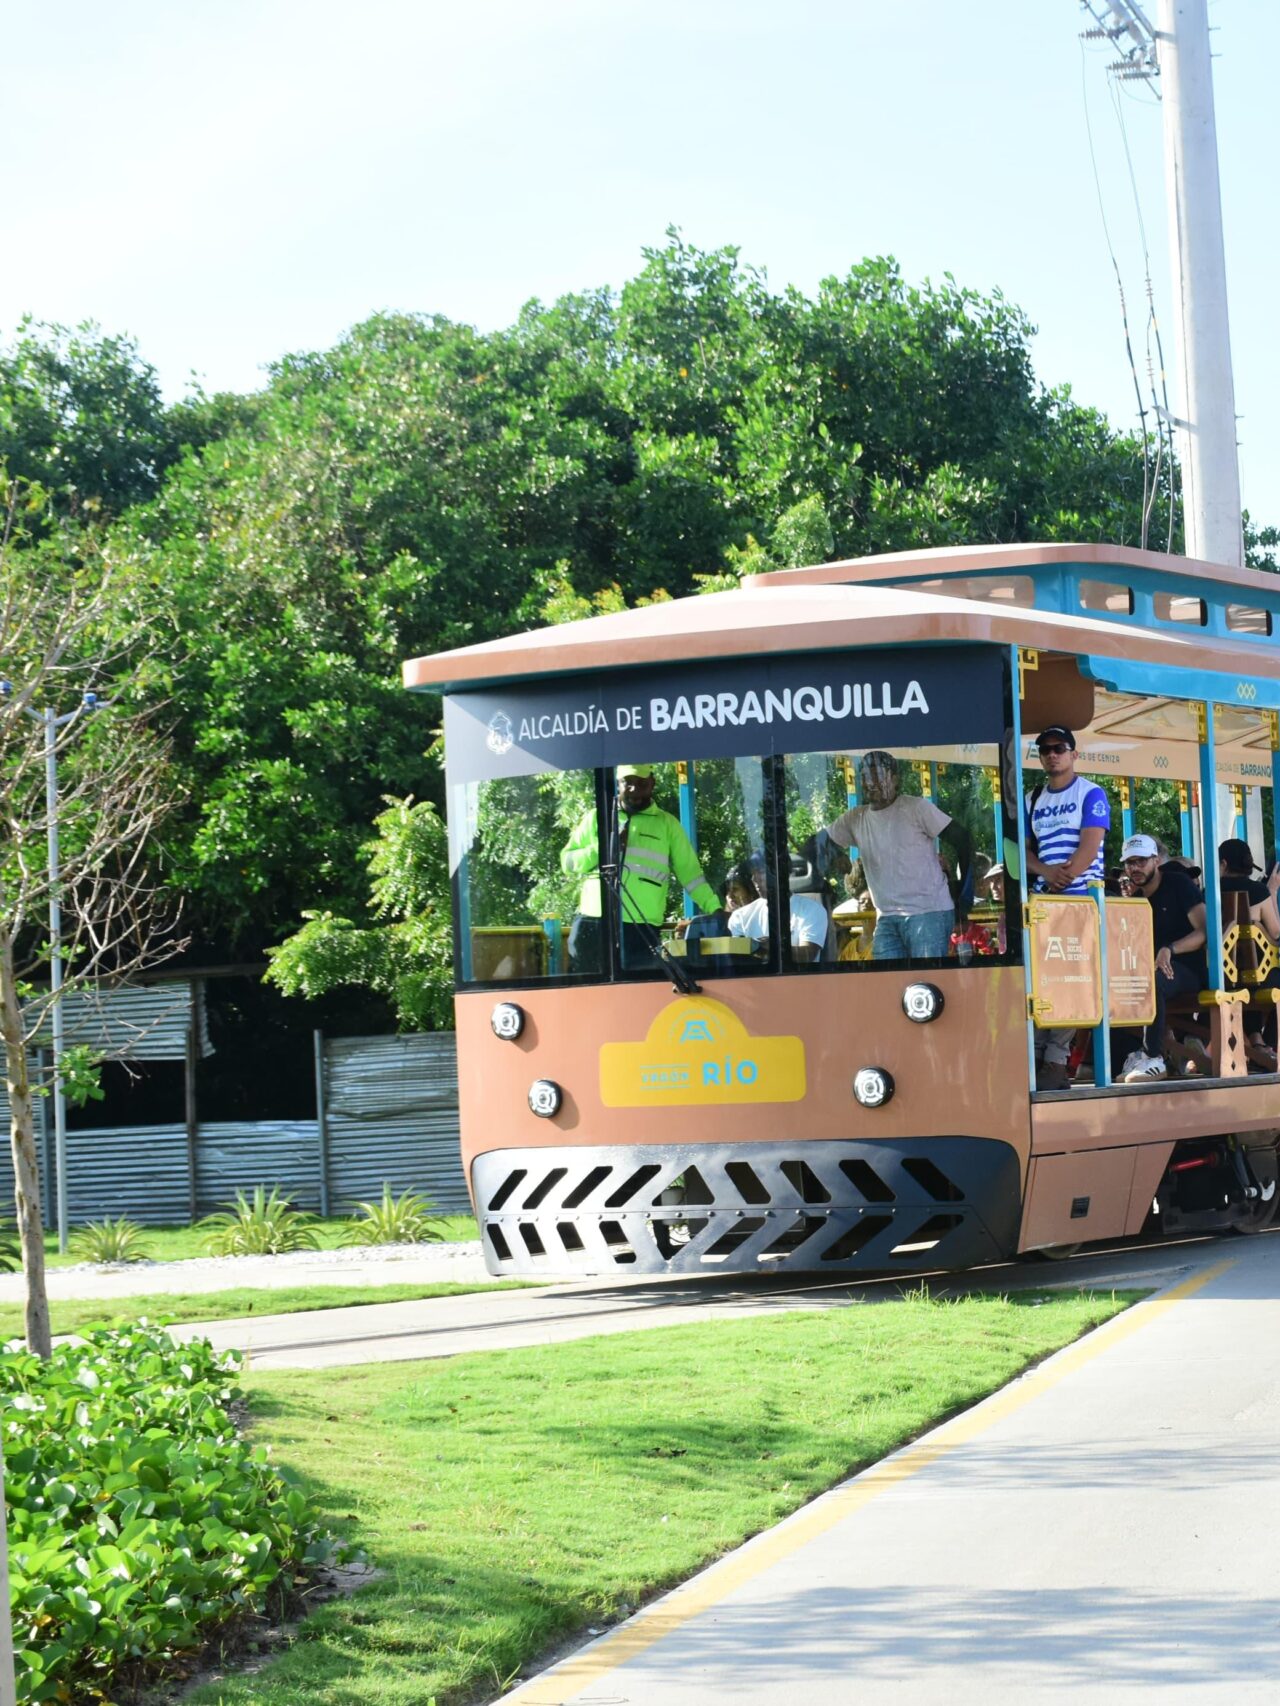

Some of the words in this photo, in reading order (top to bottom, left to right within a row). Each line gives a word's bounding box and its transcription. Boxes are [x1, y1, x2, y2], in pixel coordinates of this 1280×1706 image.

[518, 704, 609, 741] ALCALDÍA
[616, 706, 642, 730] DE
[650, 680, 929, 731] BARRANQUILLA
[1240, 763, 1271, 777] BARRANQ
[702, 1055, 758, 1086] RÍO
